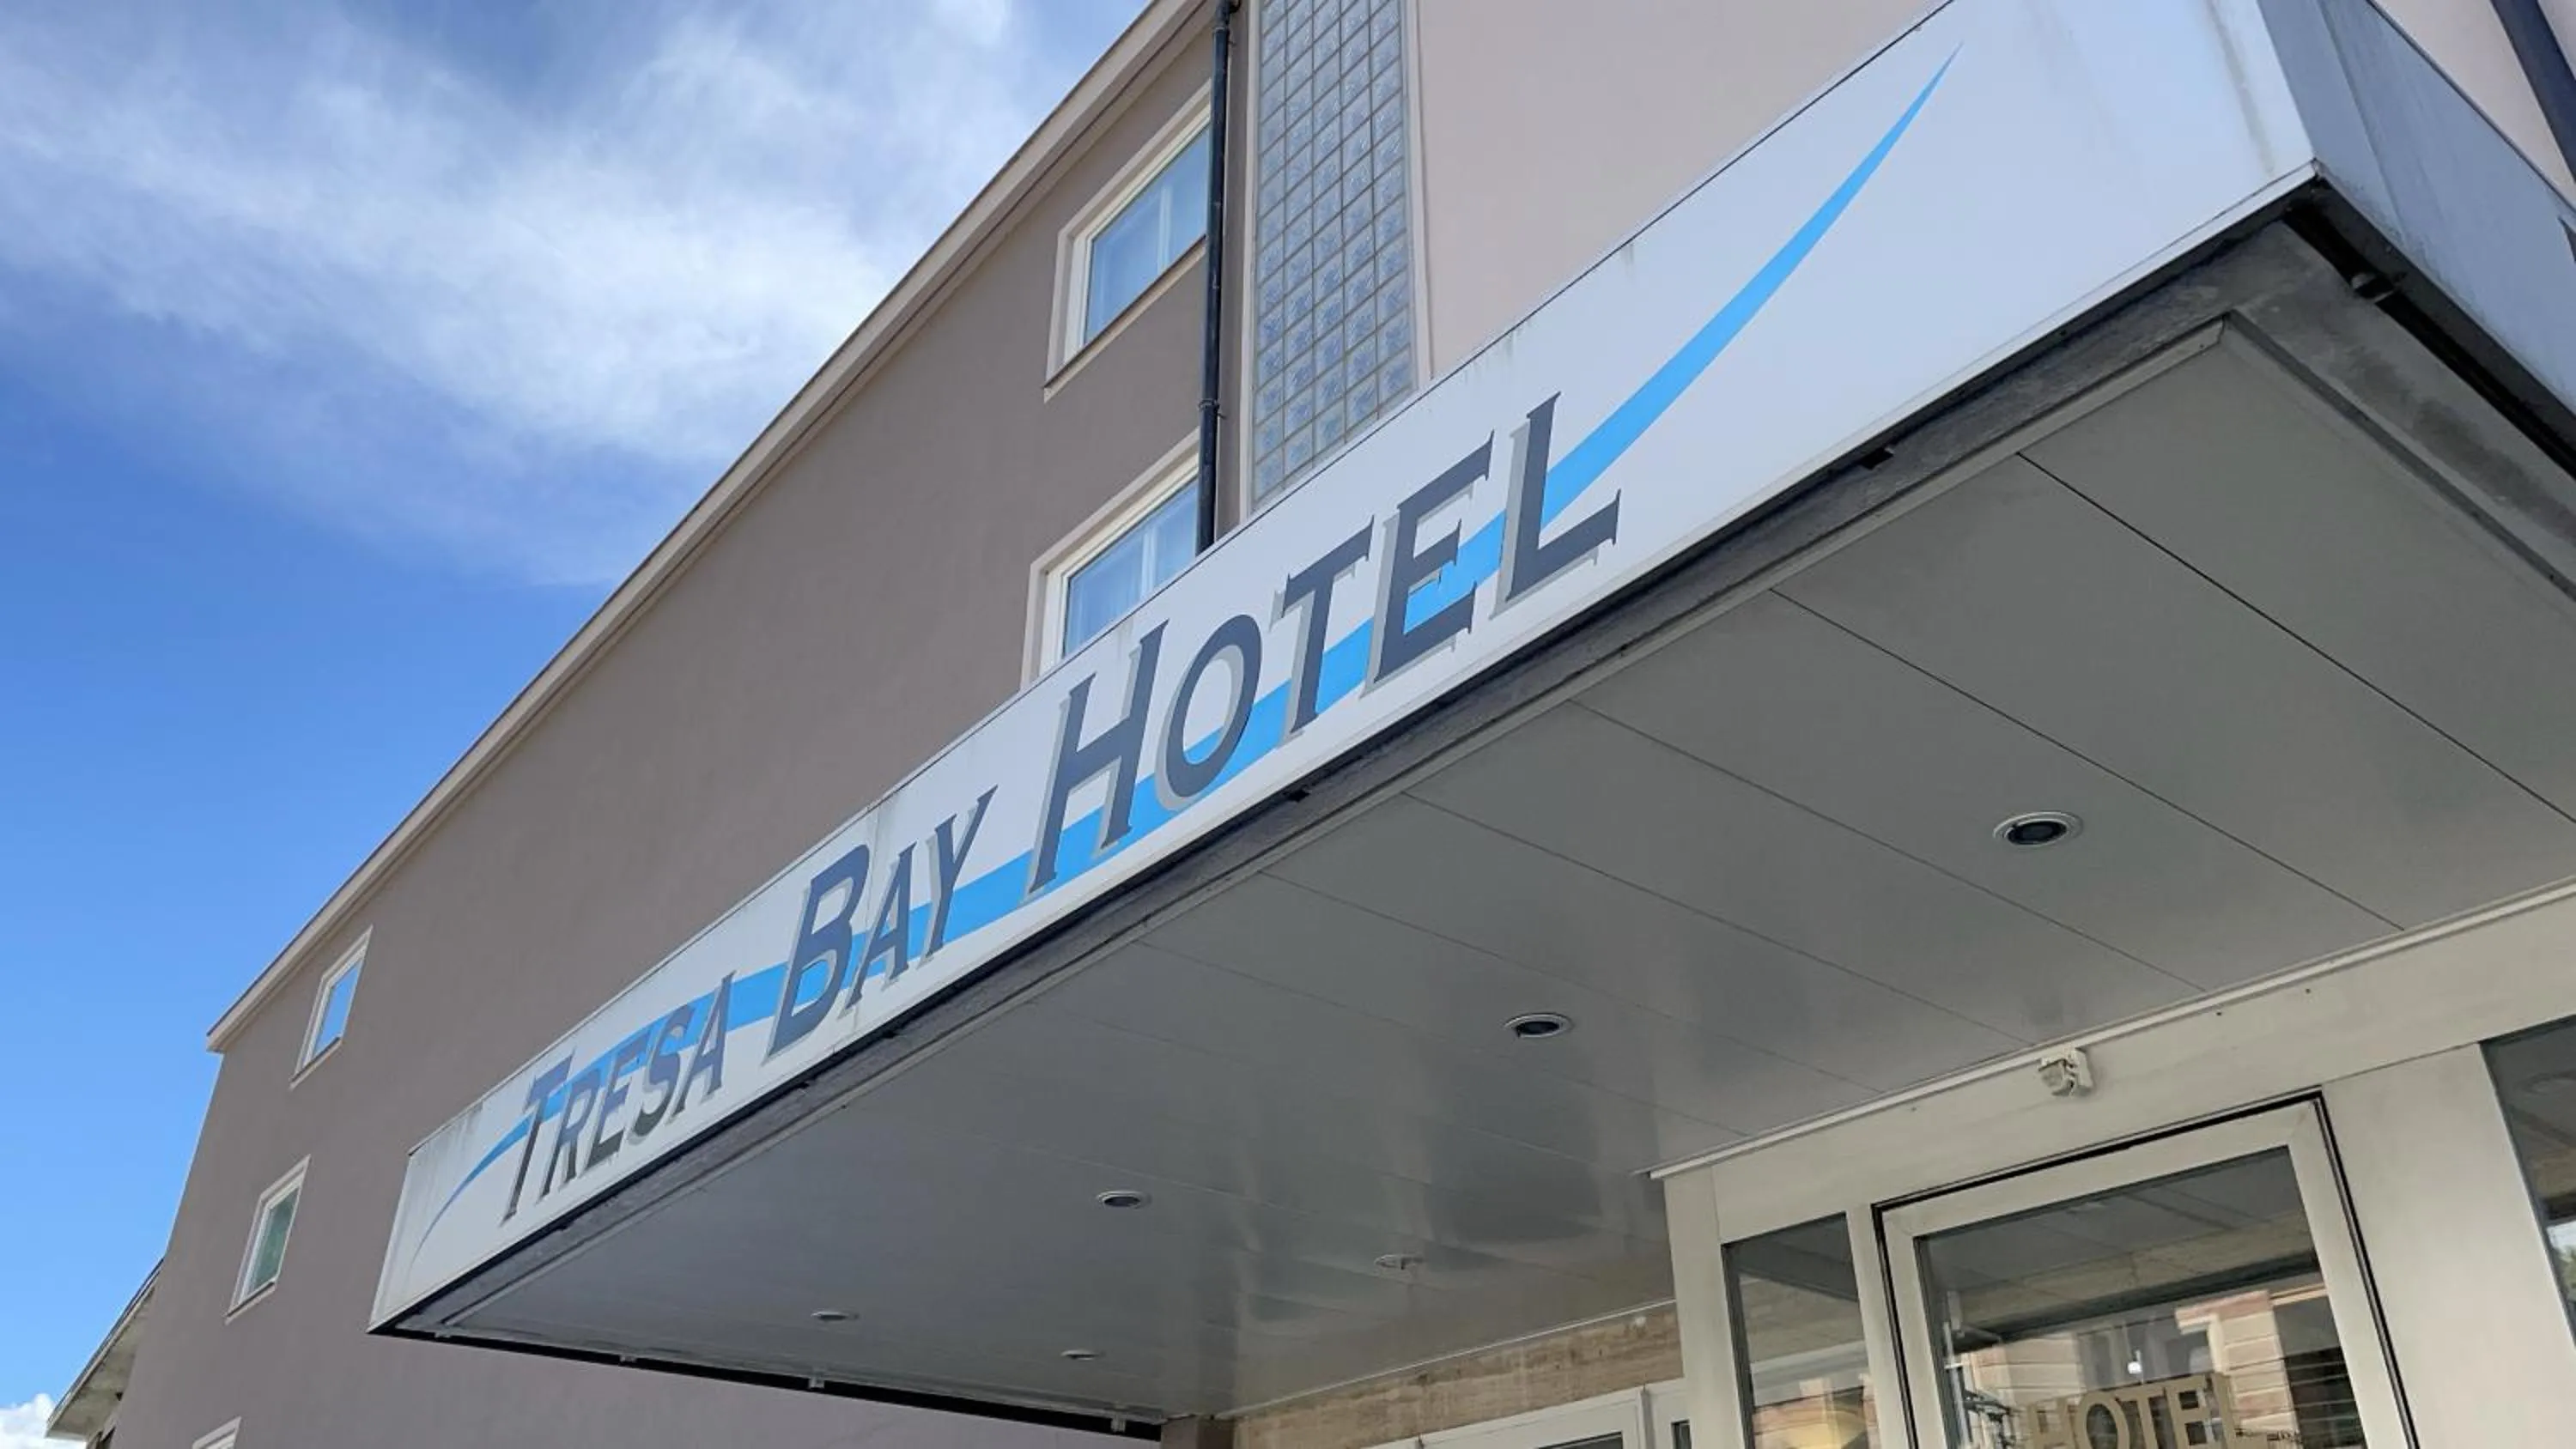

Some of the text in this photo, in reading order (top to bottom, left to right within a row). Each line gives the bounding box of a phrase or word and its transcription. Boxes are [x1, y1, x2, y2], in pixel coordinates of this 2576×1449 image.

[503, 391, 1622, 1222] TRESA BAY HOTEL
